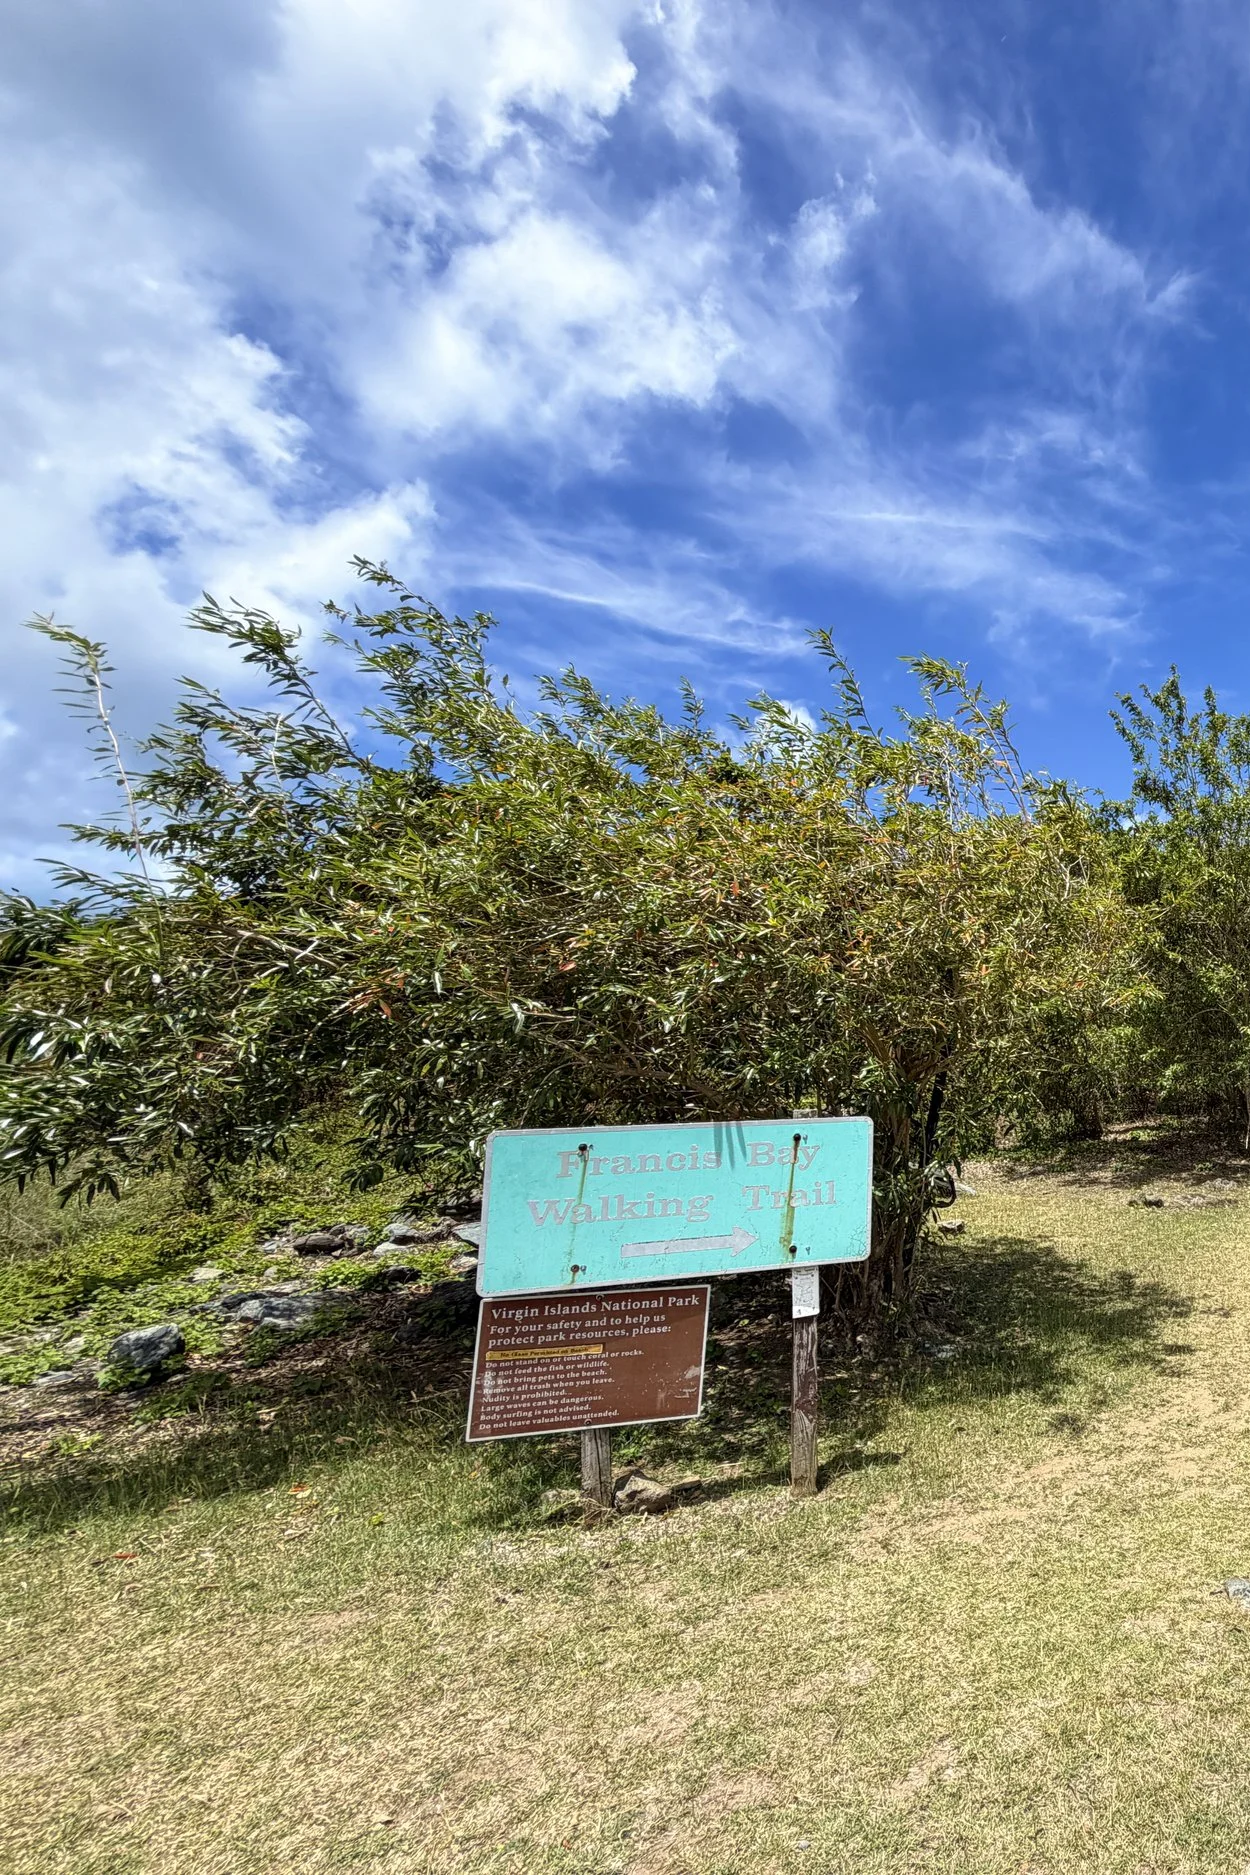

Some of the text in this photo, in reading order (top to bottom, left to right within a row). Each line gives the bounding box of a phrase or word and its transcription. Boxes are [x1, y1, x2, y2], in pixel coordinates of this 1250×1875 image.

[556, 1141, 821, 1179] Francis Bay
[527, 1180, 837, 1226] Walking Trail
[491, 1294, 700, 1321] Virgin Islands National Park
[489, 1314, 666, 1335] For your safety and to help us
[488, 1325, 671, 1349] protect park resources, please:
[515, 1358, 538, 1366] stand
[564, 1354, 586, 1362] touch
[588, 1351, 608, 1359] coral
[621, 1349, 644, 1357] rocks.
[534, 1365, 547, 1373] the
[577, 1360, 609, 1369] wildlife.
[514, 1376, 537, 1384] bring
[538, 1373, 555, 1382] pets
[582, 1369, 607, 1377] beach.
[482, 1386, 516, 1395] Remove
[552, 1380, 574, 1388] when
[482, 1394, 511, 1403] Nudity
[560, 1395, 604, 1404] dangerous.
[480, 1413, 502, 1421] Body
[559, 1404, 591, 1412] advised.
[532, 1415, 571, 1424] valuables
[572, 1409, 620, 1419] unattended.
